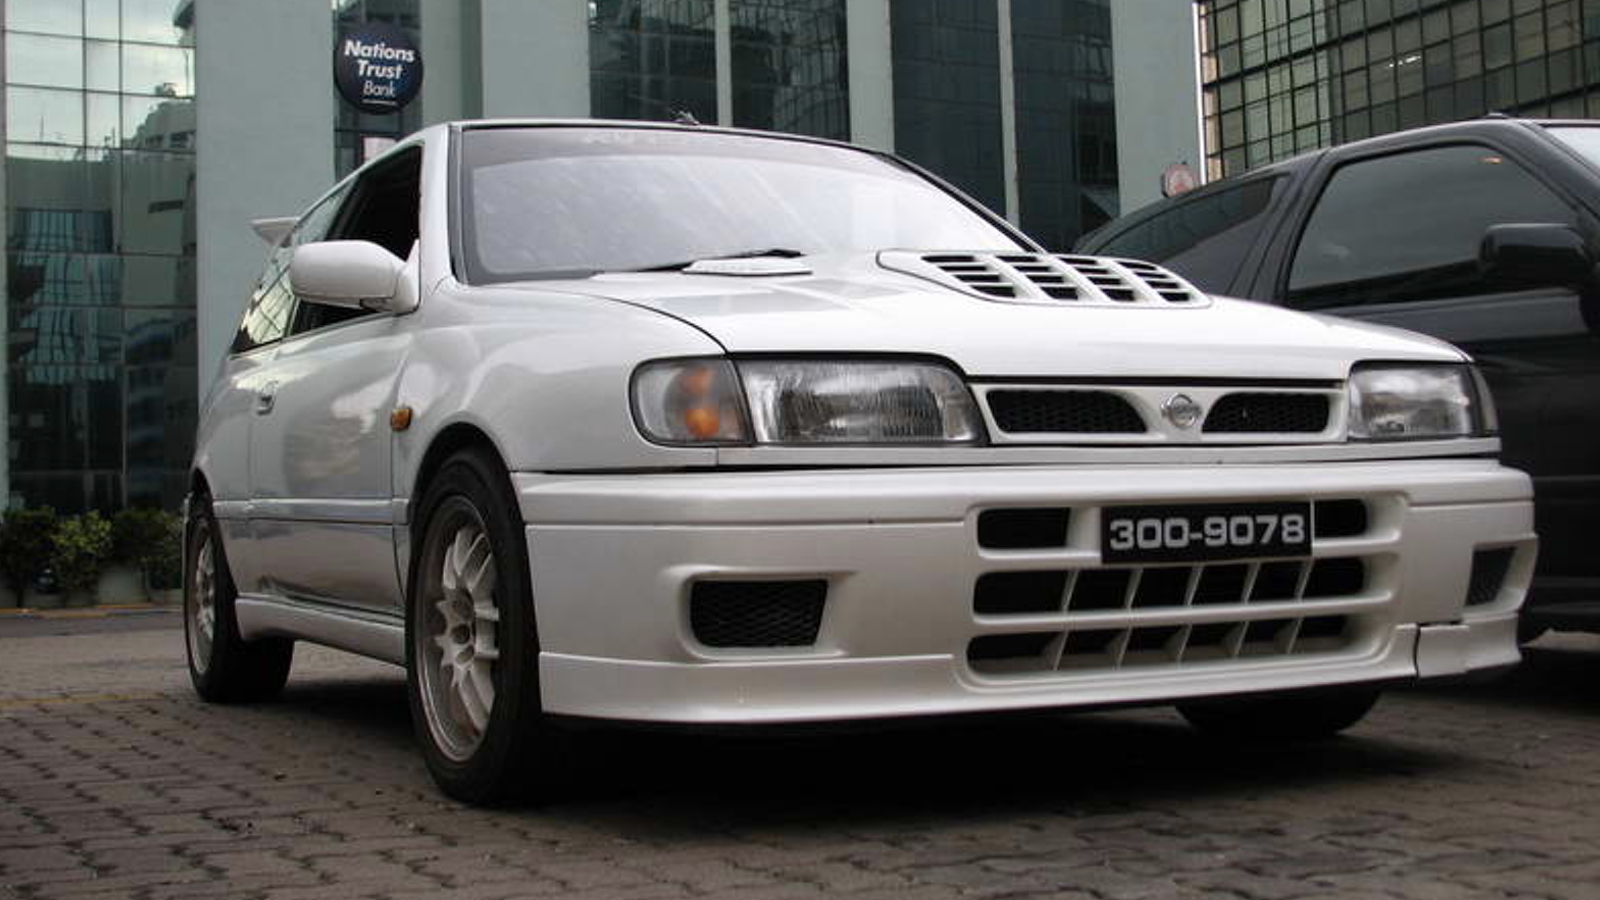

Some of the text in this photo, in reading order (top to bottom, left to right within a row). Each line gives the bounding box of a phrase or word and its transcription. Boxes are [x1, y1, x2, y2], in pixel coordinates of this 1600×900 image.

[344, 39, 415, 62] Nations
[357, 59, 403, 79] Trust
[363, 80, 396, 97] Bank
[1109, 514, 1305, 550] 300-9078
